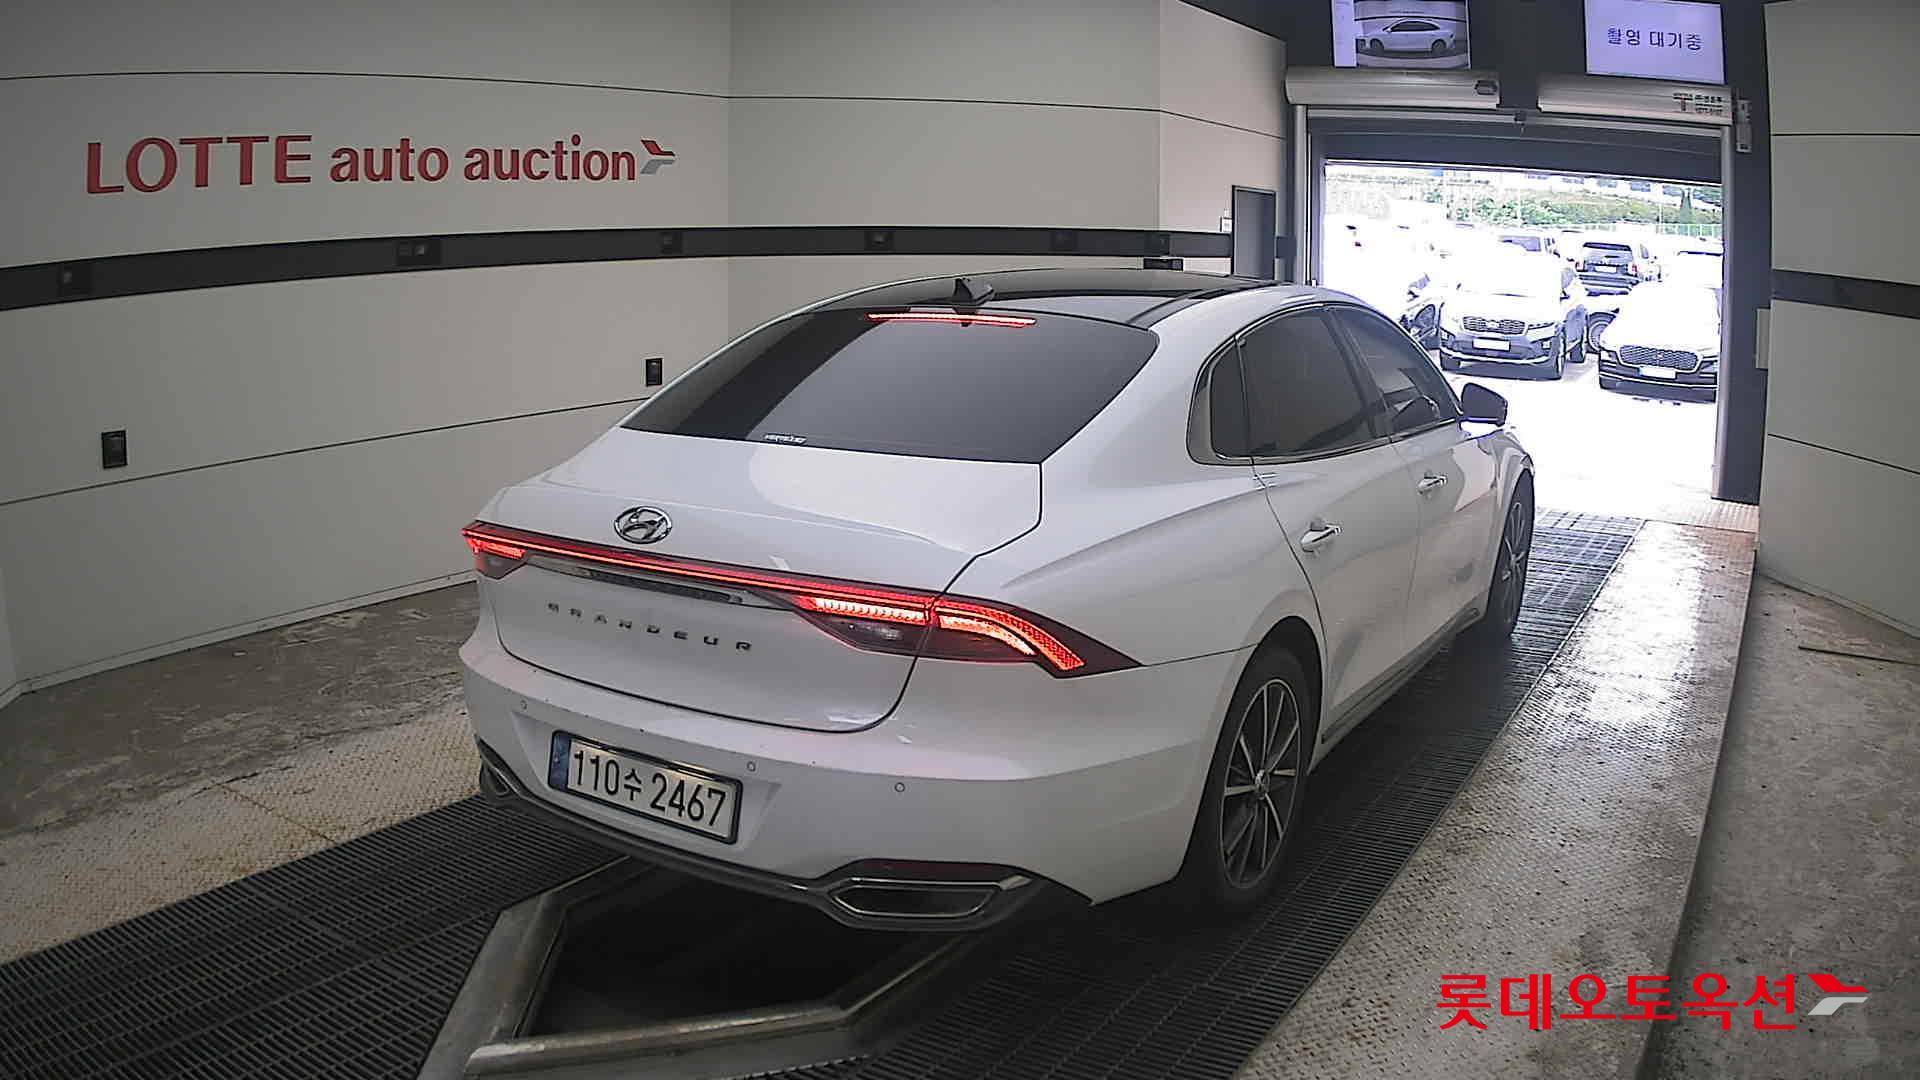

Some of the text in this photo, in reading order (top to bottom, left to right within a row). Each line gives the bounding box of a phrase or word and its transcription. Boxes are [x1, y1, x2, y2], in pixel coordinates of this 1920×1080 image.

[1649, 31, 1703, 51] 대기중
[86, 133, 637, 194] LOTTE auto auction
[547, 602, 752, 652] GRANDEUR
[573, 749, 727, 827] 110수 2467
